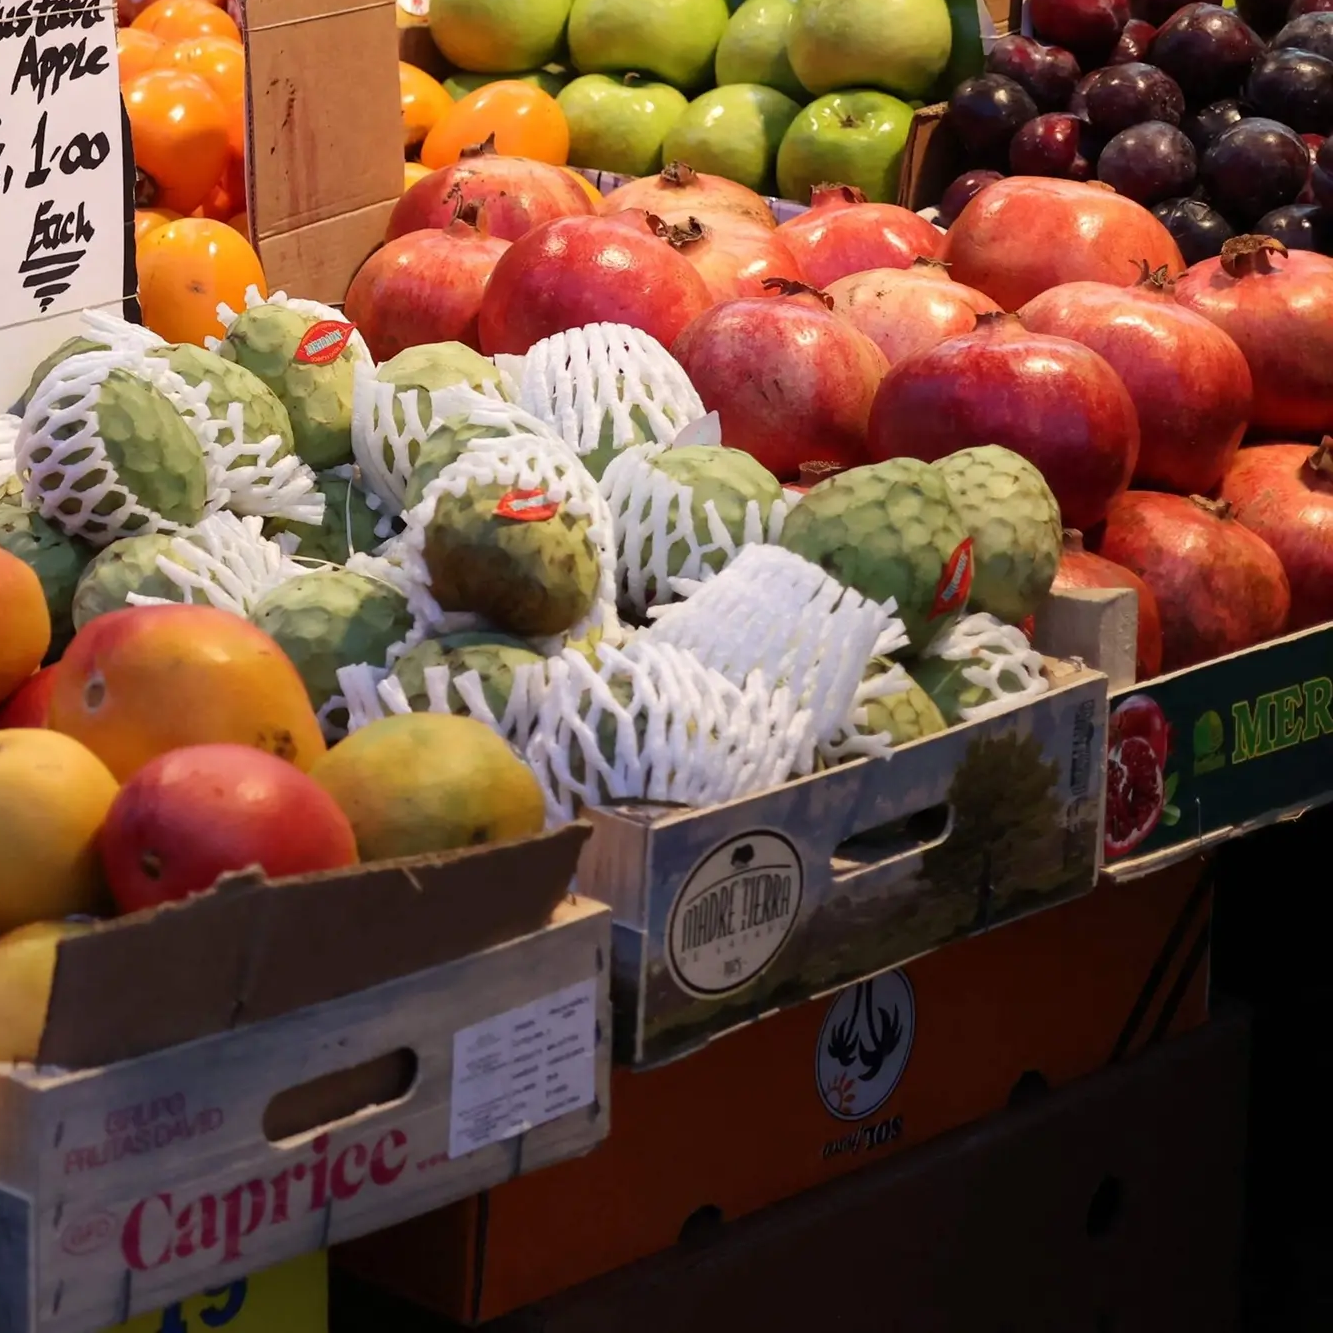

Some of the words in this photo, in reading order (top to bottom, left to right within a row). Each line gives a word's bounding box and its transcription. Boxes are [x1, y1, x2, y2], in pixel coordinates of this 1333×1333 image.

[11, 36, 110, 105] Apple
[26, 199, 96, 261] Each
[682, 880, 739, 953] MADRE
[740, 873, 792, 933] TIERRA
[104, 1091, 186, 1135] GRUPO
[120, 1129, 408, 1271] Caprice
